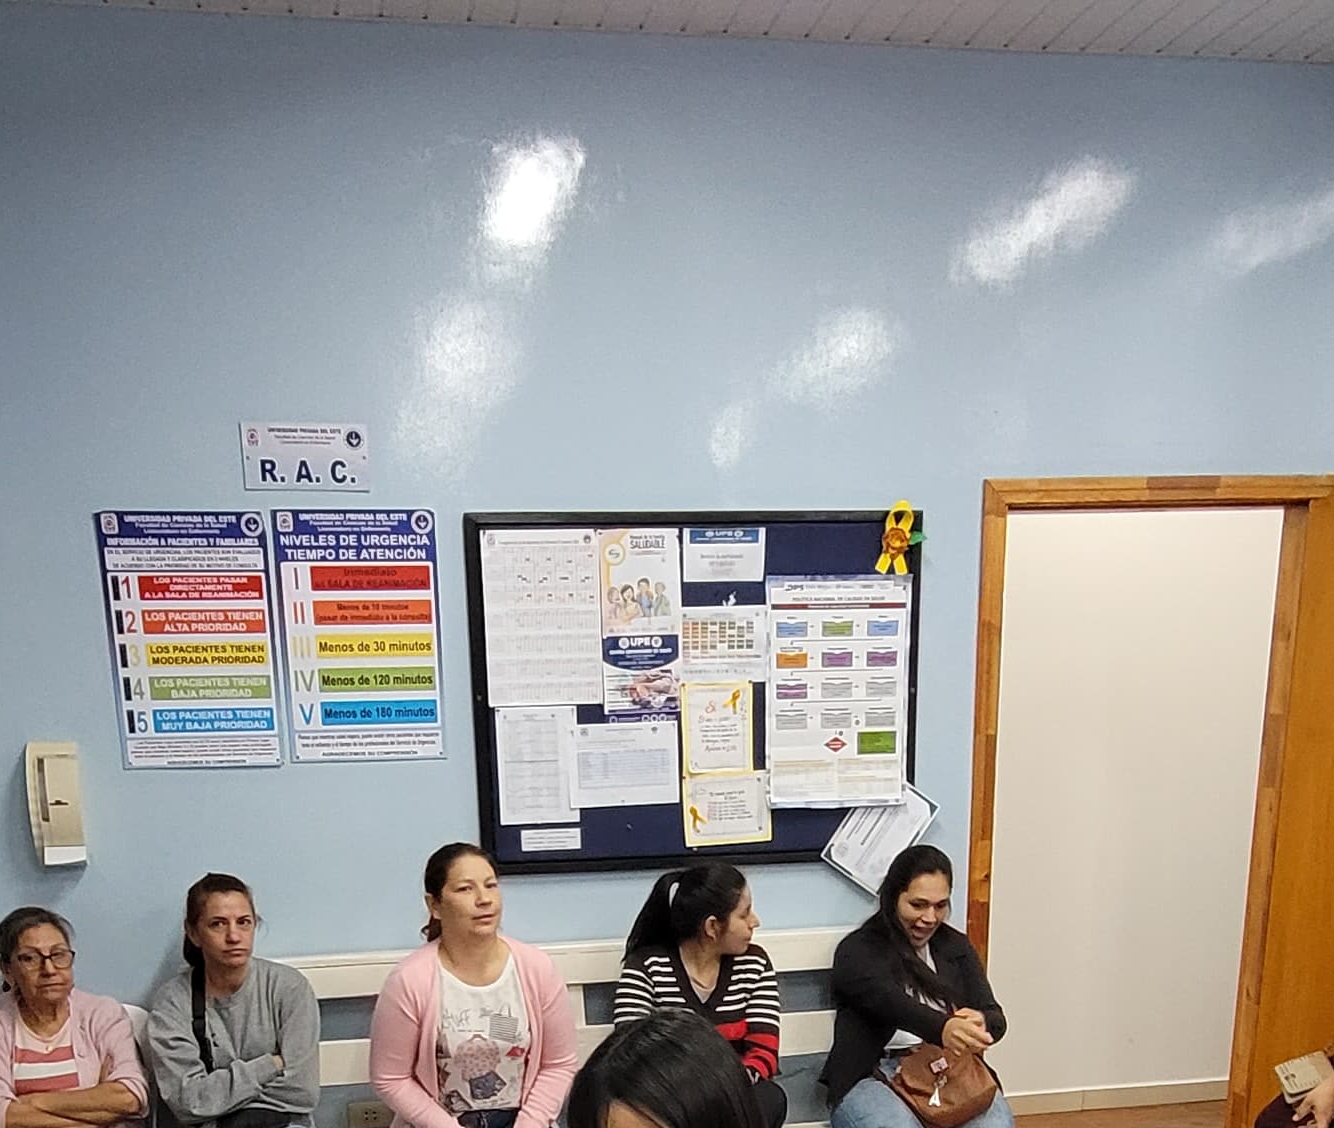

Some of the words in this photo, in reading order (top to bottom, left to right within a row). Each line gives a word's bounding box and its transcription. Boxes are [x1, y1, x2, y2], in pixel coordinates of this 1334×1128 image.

[259, 459, 285, 483] R.
[295, 460, 321, 483] A.
[330, 460, 356, 483] C.
[279, 535, 336, 546] NIVELES
[339, 534, 358, 546] DE
[361, 534, 430, 546] URGENCIA
[630, 538, 665, 550] SALUDABLE
[285, 549, 336, 560] TIEMPO
[339, 549, 357, 560] DE
[360, 546, 427, 560] ATENCIÓN
[121, 575, 132, 600] 1
[144, 612, 165, 621] LOS
[169, 612, 225, 621] PACIENTES
[228, 611, 263, 621] TIENEN
[125, 611, 137, 634] 2
[164, 623, 189, 632] ALTA
[192, 622, 247, 632] PRIORIDAD
[319, 641, 355, 653] Menos
[357, 640, 371, 652] de
[373, 641, 386, 652] 30
[389, 640, 432, 652] minutos
[630, 637, 651, 647] UPE
[129, 644, 141, 667] 3
[150, 645, 171, 655] LOS
[173, 645, 227, 654] PACIENTES
[230, 644, 265, 653] TIENEN
[152, 656, 209, 665] MODERADA
[212, 655, 265, 664] PRIORIDAD
[154, 678, 175, 688] LOS
[177, 677, 229, 687] PACIENTES
[232, 677, 267, 686] TIENEN
[294, 670, 315, 692] IV
[321, 675, 355, 686] Menos
[358, 674, 371, 686] de
[373, 674, 391, 685] 120
[393, 674, 433, 685] minutos
[133, 678, 145, 701] 4
[171, 689, 198, 699] BAJA
[200, 688, 252, 698] PRIORIDAD
[157, 711, 177, 720] LOS
[179, 711, 233, 720] PACIENTES
[236, 710, 271, 719] TIENEN
[299, 704, 314, 725] V
[324, 708, 357, 719] Menos
[360, 707, 373, 719] de
[375, 707, 392, 718] 180
[395, 707, 435, 718] minutos
[137, 711, 148, 733] 5
[161, 722, 184, 730] MUY
[186, 721, 212, 730] BAJA
[215, 720, 267, 729] PRIORIDAD
